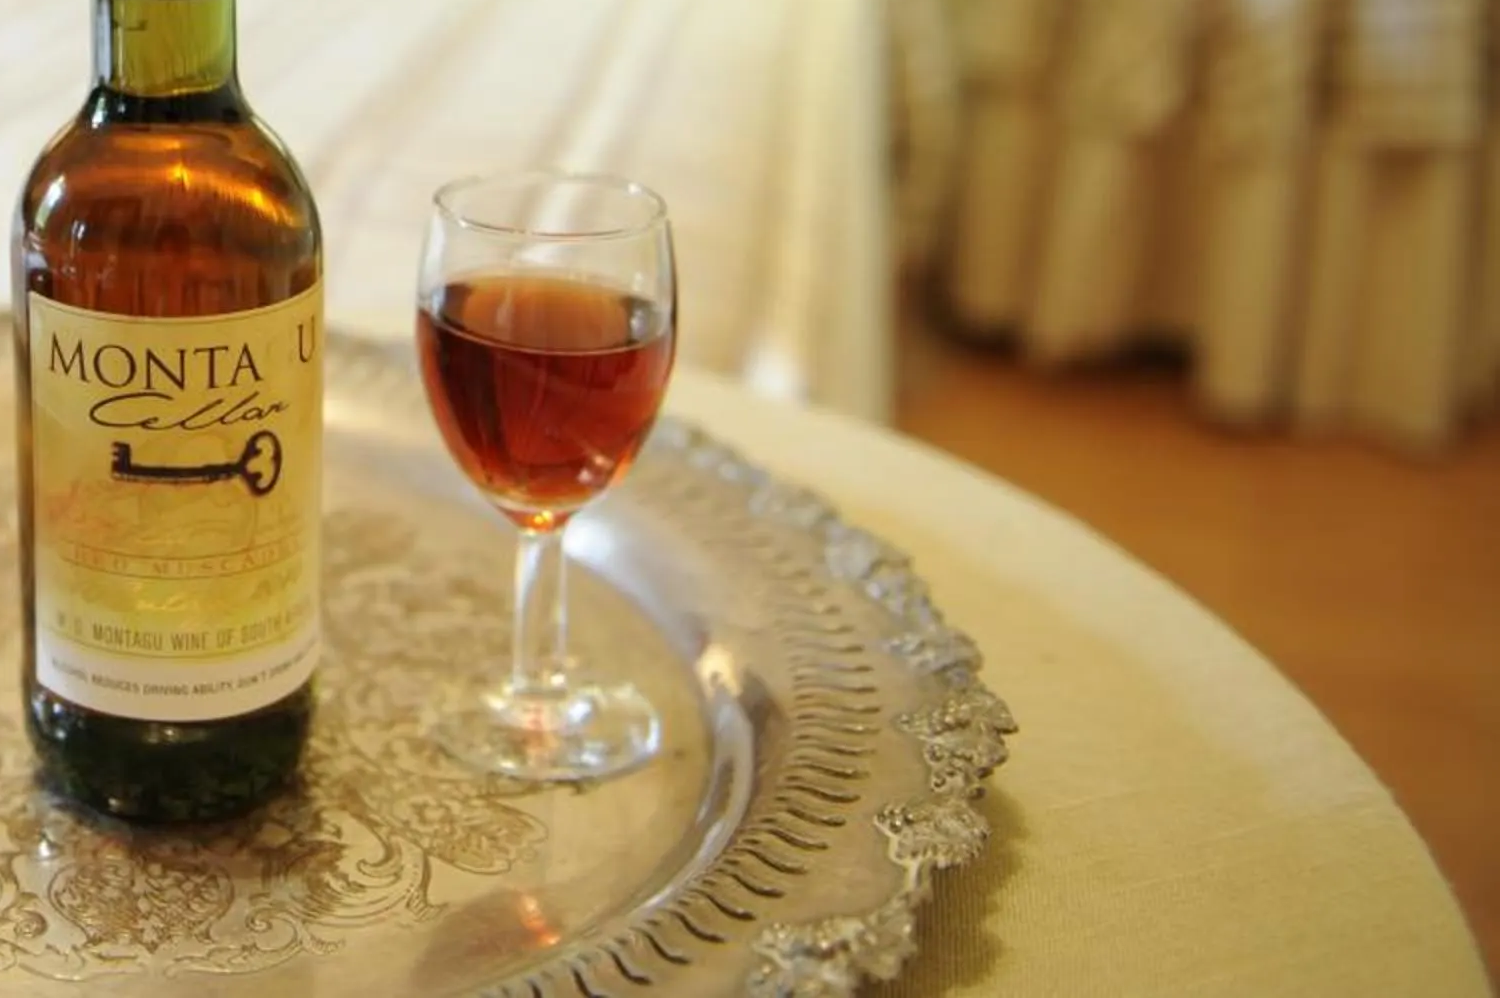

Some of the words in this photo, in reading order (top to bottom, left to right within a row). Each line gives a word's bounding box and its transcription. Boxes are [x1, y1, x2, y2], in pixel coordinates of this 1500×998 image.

[49, 314, 316, 391] MONTAU
[89, 391, 289, 431] Cellar
[92, 622, 165, 652] MONTAGU
[171, 631, 210, 652] WINE
[216, 627, 235, 650] OF
[142, 681, 193, 698] DRIVING
